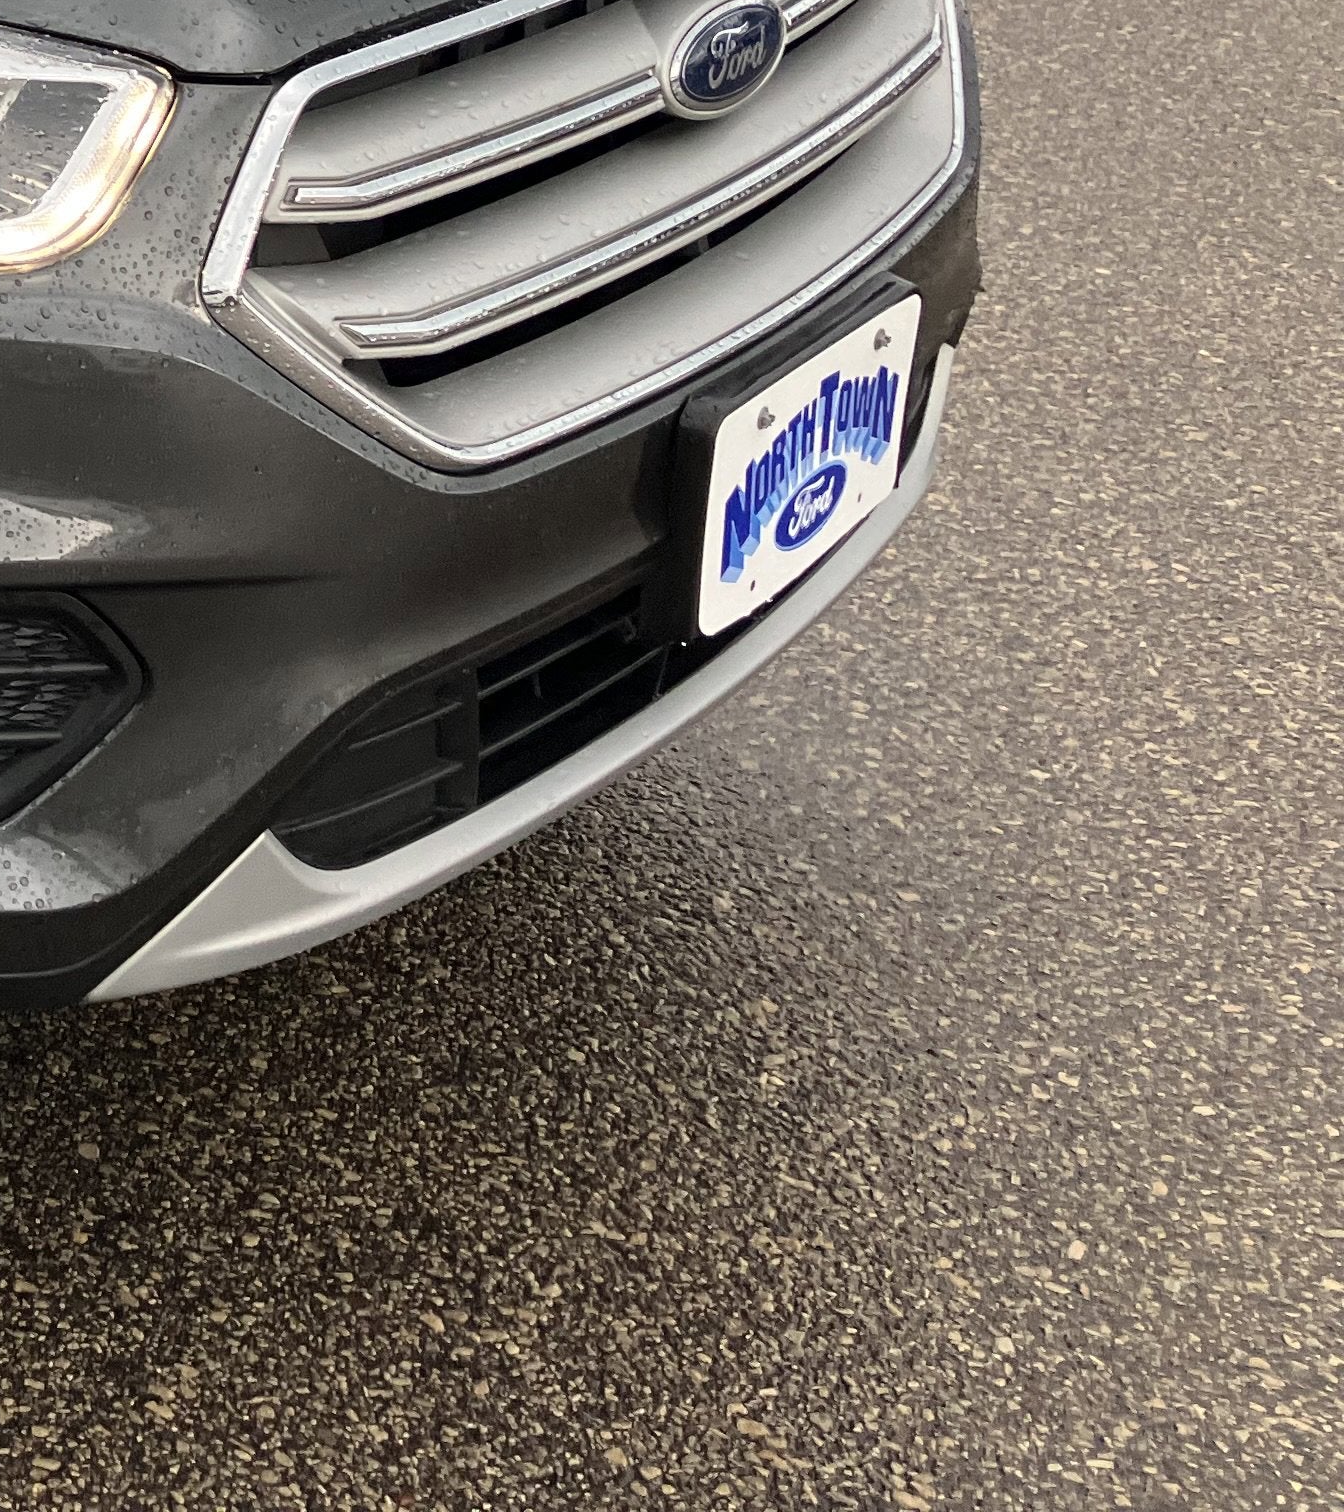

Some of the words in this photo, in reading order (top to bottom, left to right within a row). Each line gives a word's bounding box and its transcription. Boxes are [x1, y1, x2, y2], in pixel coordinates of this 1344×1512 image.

[708, 21, 768, 90] Ford
[720, 399, 817, 583] NORTH
[819, 365, 900, 463] TOWN
[787, 480, 836, 541] Ford
